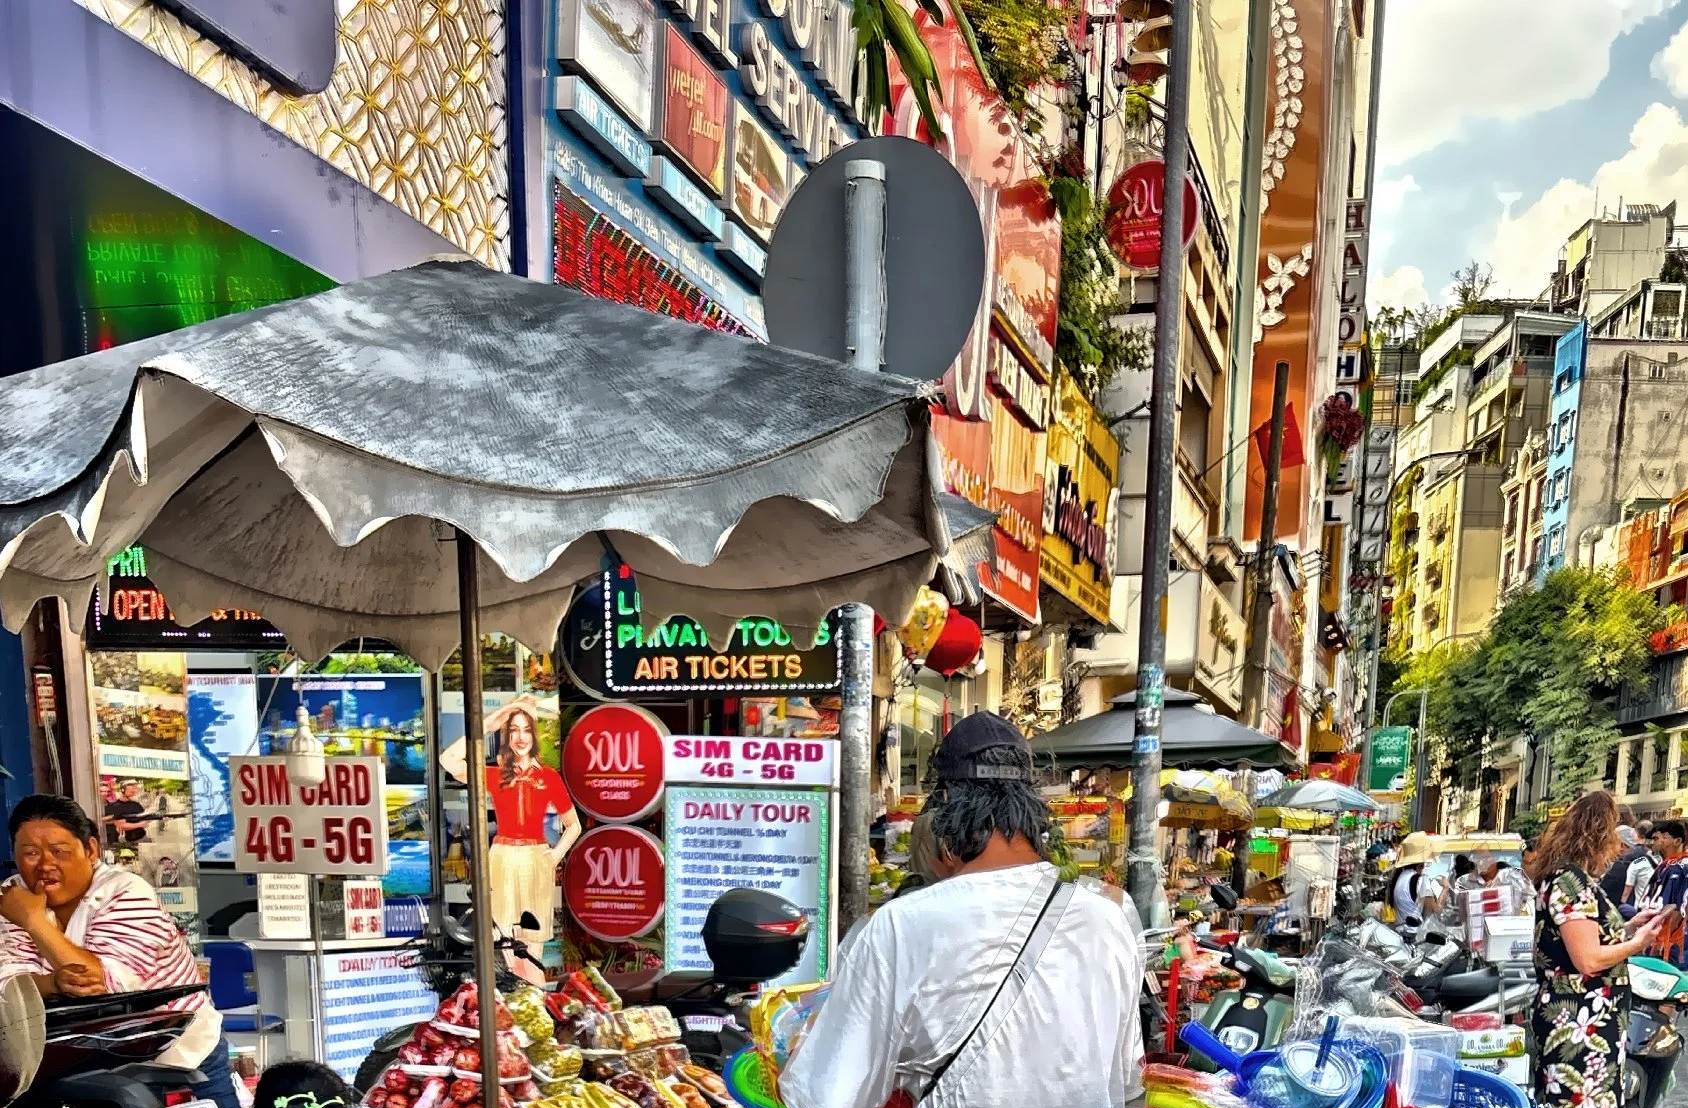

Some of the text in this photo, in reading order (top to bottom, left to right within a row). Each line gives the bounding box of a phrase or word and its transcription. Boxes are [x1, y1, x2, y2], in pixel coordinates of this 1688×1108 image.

[578, 90, 598, 127] AIR
[1121, 178, 1165, 219] SOU
[113, 589, 165, 621] OPEN
[617, 621, 709, 648] PIVAT
[735, 617, 830, 647] TOUS
[634, 654, 803, 680] AIR TICKETS
[583, 730, 645, 773] SOUL
[673, 739, 824, 763] SIM CARD
[700, 762, 735, 778] 4G
[761, 764, 796, 780] 5G
[238, 763, 292, 806] SIM
[684, 801, 812, 823] DAILY TOUR
[245, 814, 296, 863] 4G
[322, 815, 375, 865] 5G
[716, 827, 755, 838] TUNNEL
[764, 829, 788, 838] DAY
[583, 846, 645, 887] SOUL
[682, 877, 722, 888] MEKONG
[722, 878, 755, 888] DELTA
[682, 903, 711, 912] MEKON
[338, 957, 377, 973] DAILY
[682, 960, 713, 969] SAIGO
